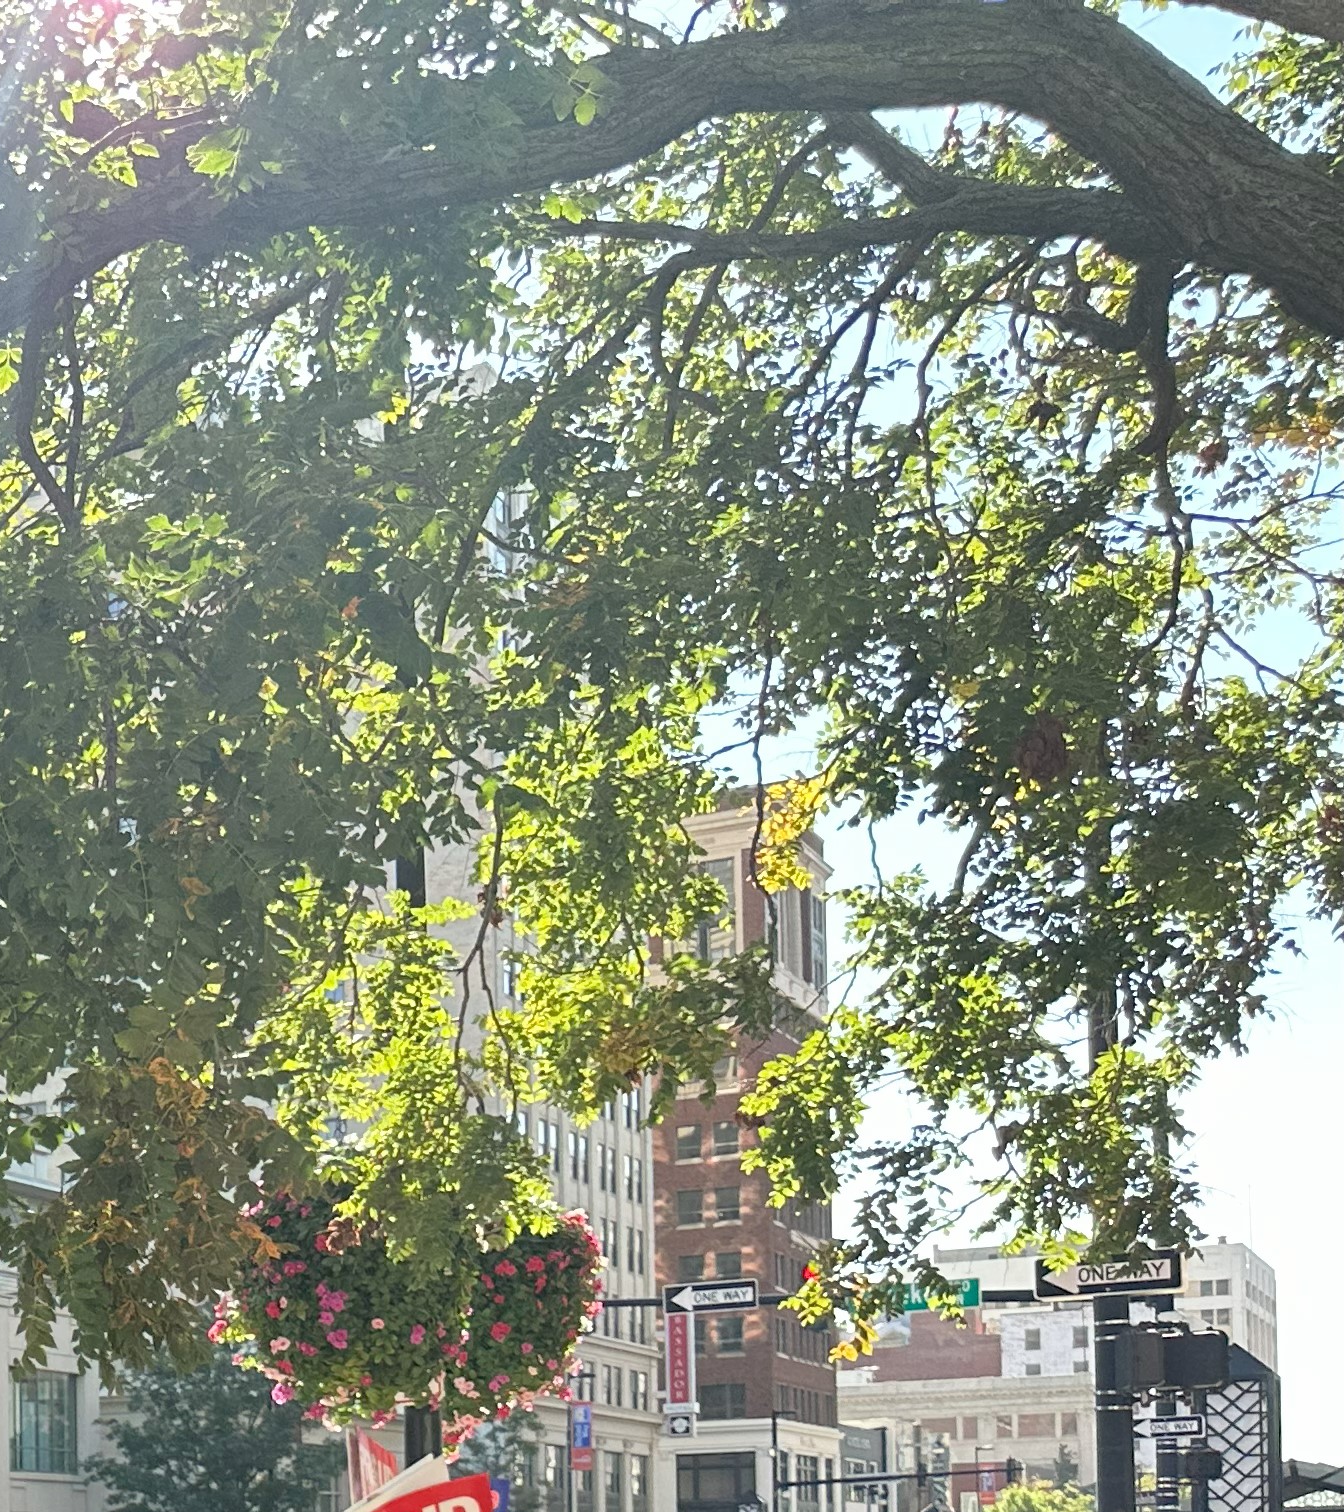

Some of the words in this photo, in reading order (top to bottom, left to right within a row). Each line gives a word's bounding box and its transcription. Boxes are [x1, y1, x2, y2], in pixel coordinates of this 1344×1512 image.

[1078, 1266, 1116, 1282] ONE
[693, 1291, 719, 1304] ONE
[723, 1289, 750, 1301] WAY
